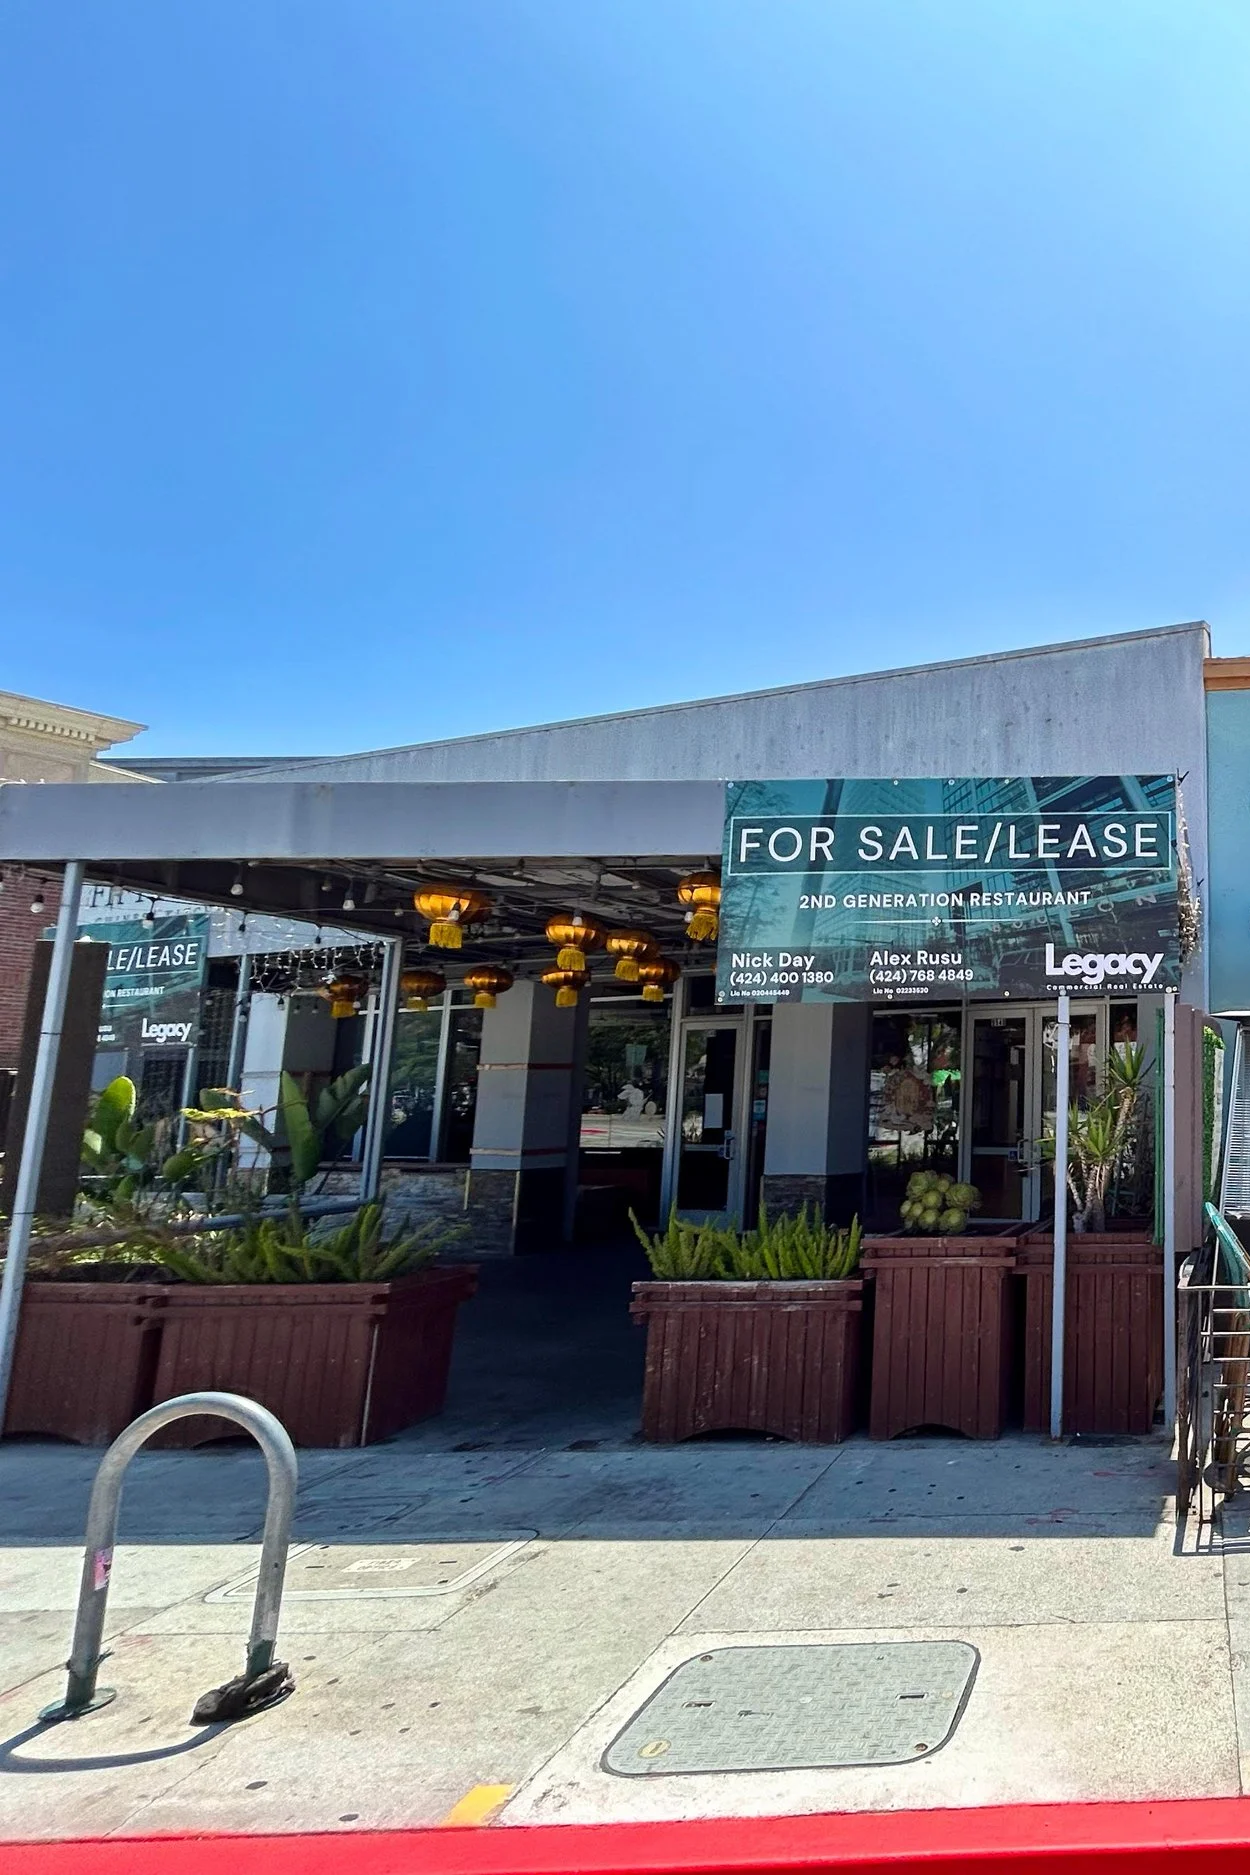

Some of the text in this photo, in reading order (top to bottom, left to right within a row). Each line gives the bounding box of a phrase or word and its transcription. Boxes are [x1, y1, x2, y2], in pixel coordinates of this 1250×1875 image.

[739, 822, 1159, 864] FOR SALE/LEASE
[800, 891, 1092, 909] 2ND GENERATION RESTAURANT
[107, 943, 199, 971] LE/LEASE
[731, 953, 815, 971] Nick Day
[870, 951, 962, 965] Alex Rusu
[1045, 943, 1164, 985] Legacy
[730, 971, 833, 986] (424) 400 1380
[870, 968, 974, 984] (424) 768 4849
[117, 986, 165, 998] RESTAURANT
[141, 1018, 192, 1043] Legacy
